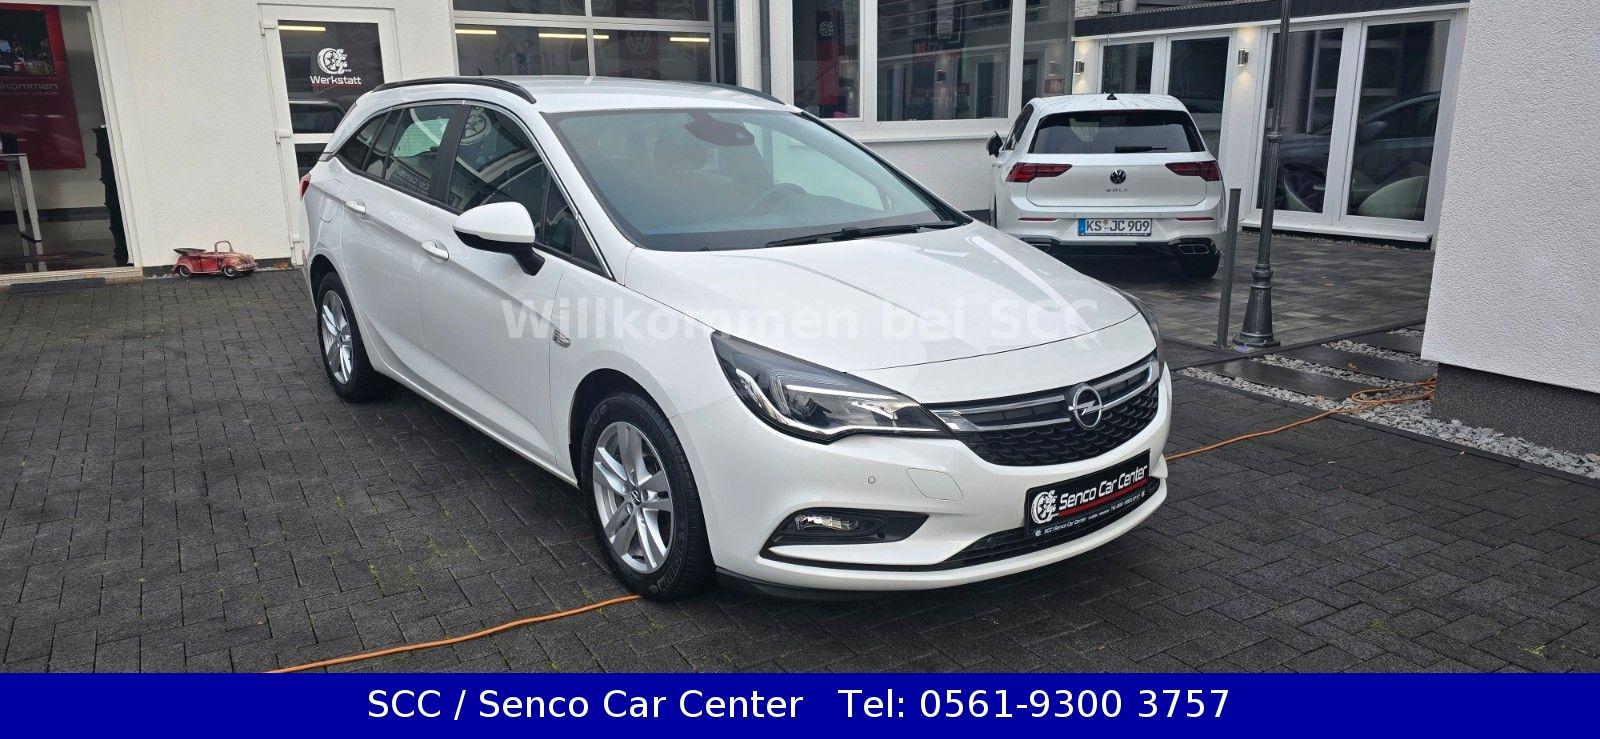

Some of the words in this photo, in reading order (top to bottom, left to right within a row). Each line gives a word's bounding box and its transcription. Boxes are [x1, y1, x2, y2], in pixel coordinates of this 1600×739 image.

[309, 75, 362, 85] Werkstatt
[1086, 220, 1102, 232] KS
[1110, 220, 1125, 232] JC
[1127, 220, 1150, 232] 909
[1058, 486, 1097, 511] Senco
[1098, 479, 1118, 498] Car
[1117, 465, 1148, 489] Center
